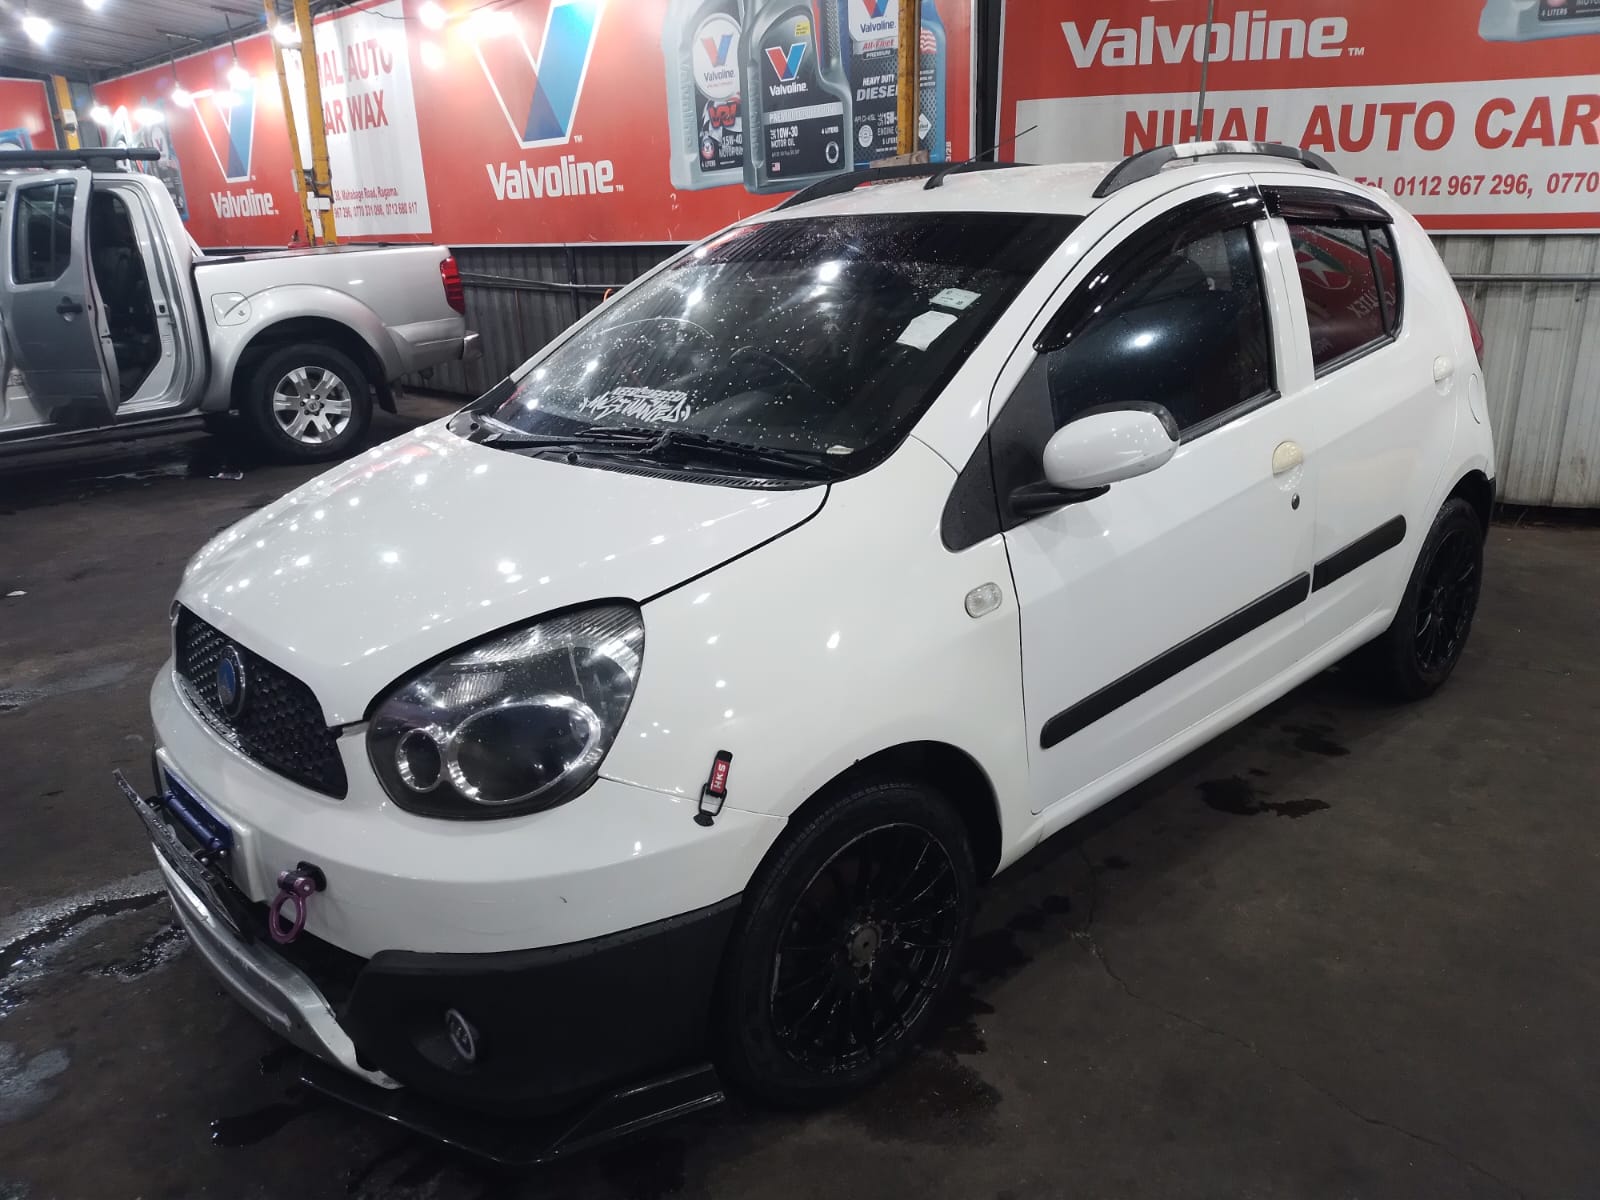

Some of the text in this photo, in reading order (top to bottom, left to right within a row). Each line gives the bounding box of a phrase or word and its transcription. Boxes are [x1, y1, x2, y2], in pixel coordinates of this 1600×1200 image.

[1547, 8, 1568, 17] LITERS
[860, 20, 895, 34] Valvoline
[1060, 9, 1348, 69] Valvoline
[347, 38, 393, 82] AUTO
[704, 69, 735, 83] Valvoline
[769, 82, 807, 97] Valvoline
[862, 73, 895, 87] HEAVY DUTY
[324, 88, 389, 136] AR WAX
[1123, 94, 1600, 157] NIHAL AUTO CAR
[776, 125, 798, 139] 10W-30
[485, 154, 614, 201] Valvoline
[1393, 175, 1442, 197] 0112
[1447, 174, 1485, 196] 967
[1489, 173, 1533, 199] 296,
[1546, 171, 1599, 194] 0770
[211, 189, 275, 219] Valvoline
[713, 763, 726, 790] HKS
